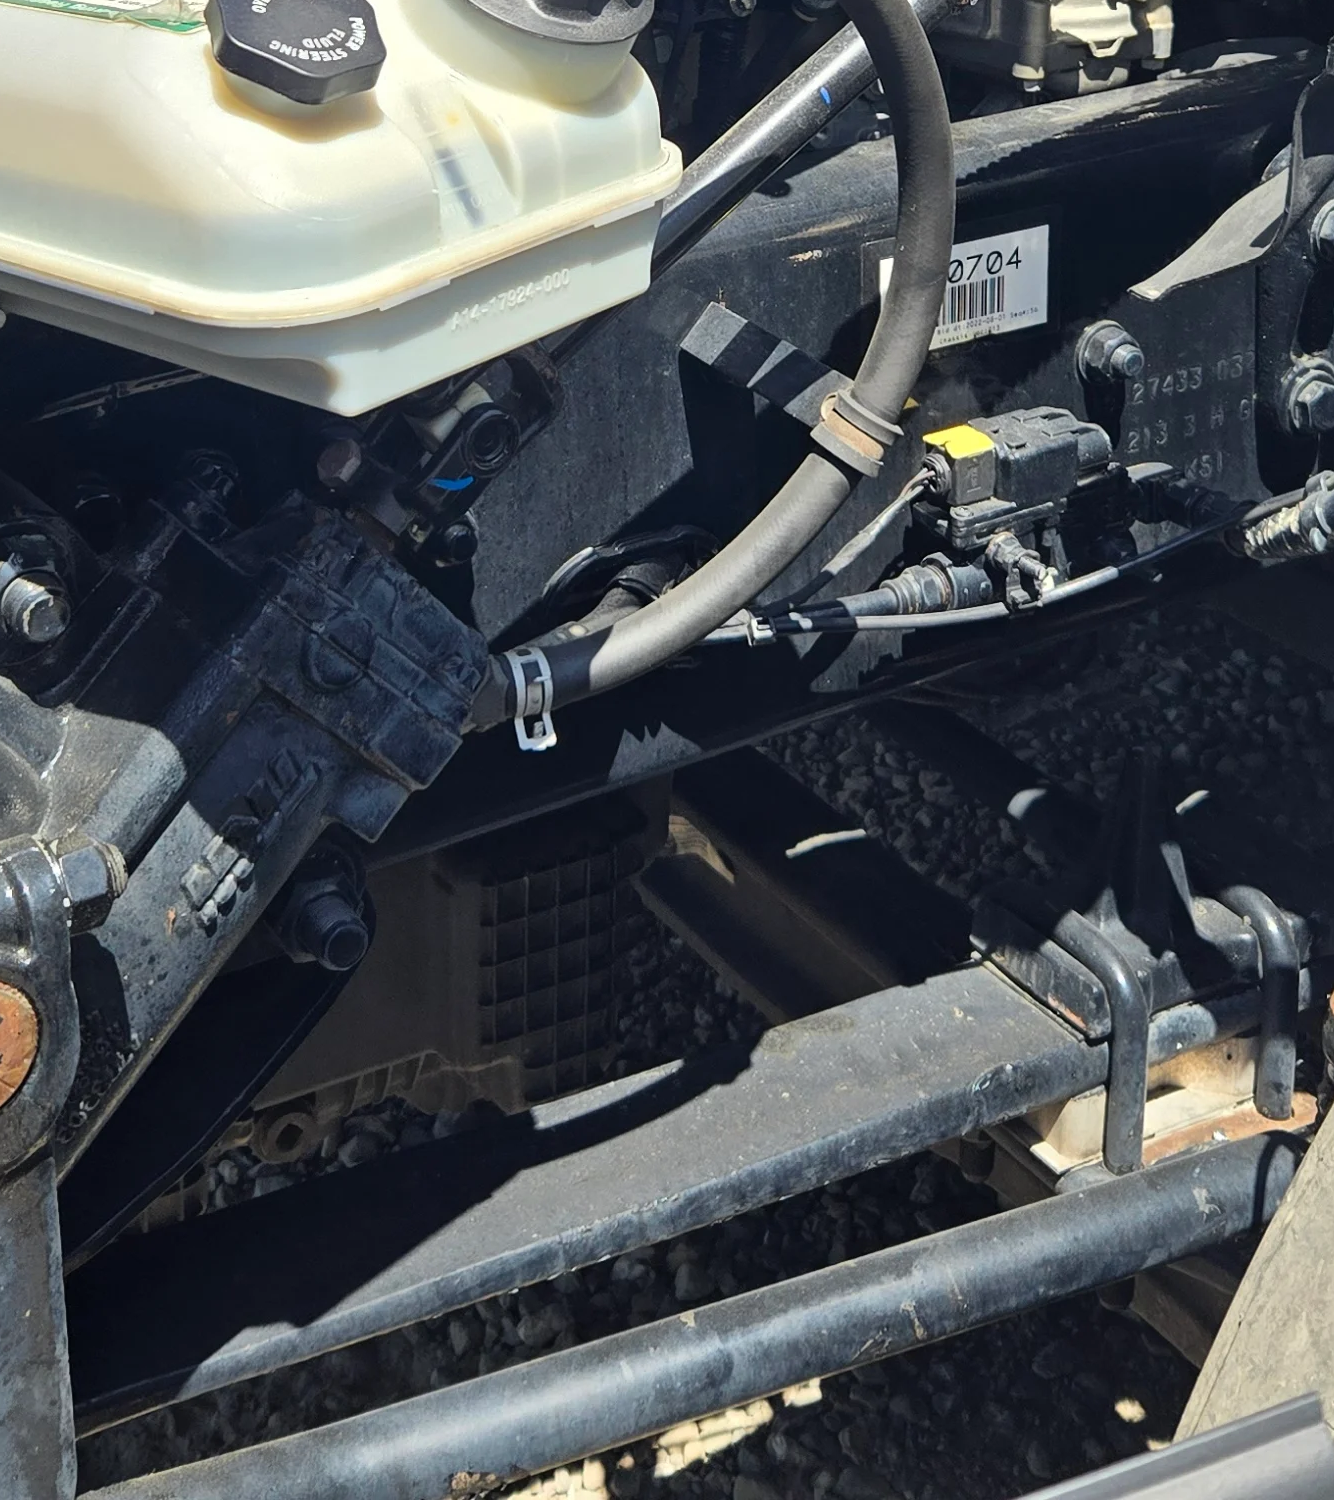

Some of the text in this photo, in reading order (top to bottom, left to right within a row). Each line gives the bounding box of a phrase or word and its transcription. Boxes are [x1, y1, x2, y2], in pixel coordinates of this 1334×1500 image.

[269, 17, 366, 62] POWER STEERING
[301, 28, 346, 49] FLUID
[947, 246, 1022, 284] 0704
[451, 268, 570, 331] A14-17924-000
[1131, 366, 1203, 405] 27433
[1128, 419, 1168, 453] 213
